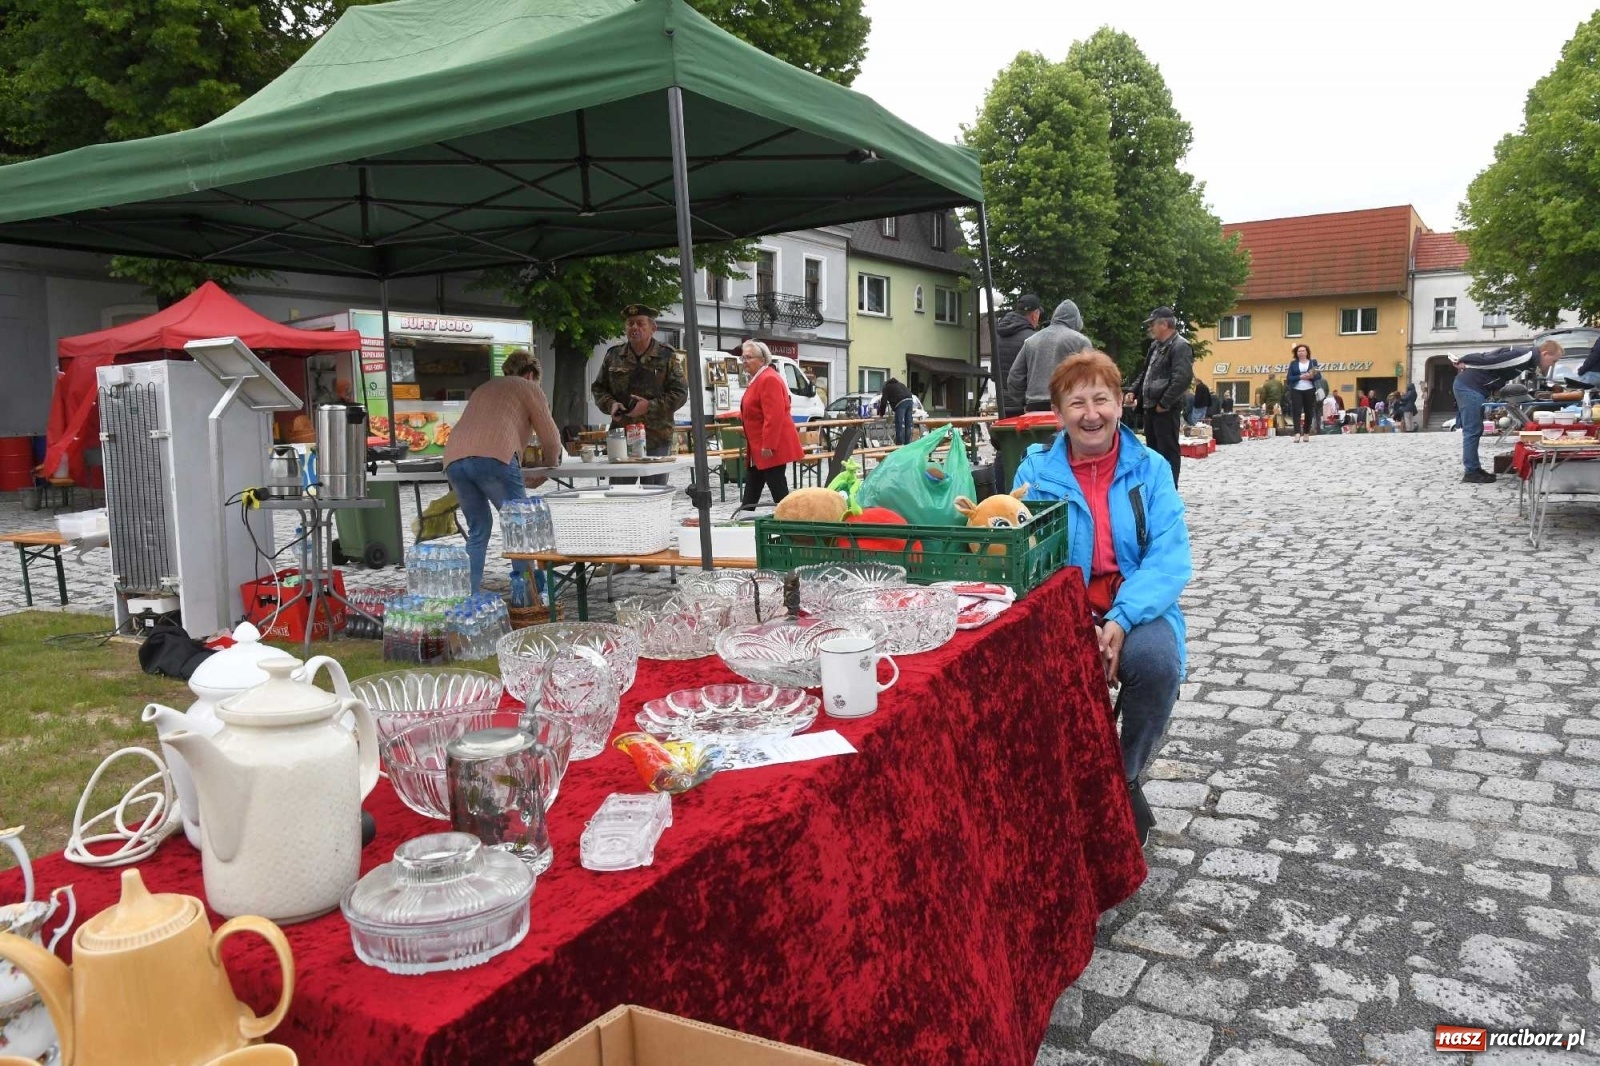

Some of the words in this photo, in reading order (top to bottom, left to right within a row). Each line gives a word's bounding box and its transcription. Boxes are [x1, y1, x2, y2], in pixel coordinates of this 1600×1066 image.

[401, 317, 438, 331] BUFET
[439, 319, 474, 333] BOBO
[1236, 364, 1272, 375] BANK
[1273, 360, 1374, 375] SPZIELCZY
[313, 612, 343, 633] TYSIE
